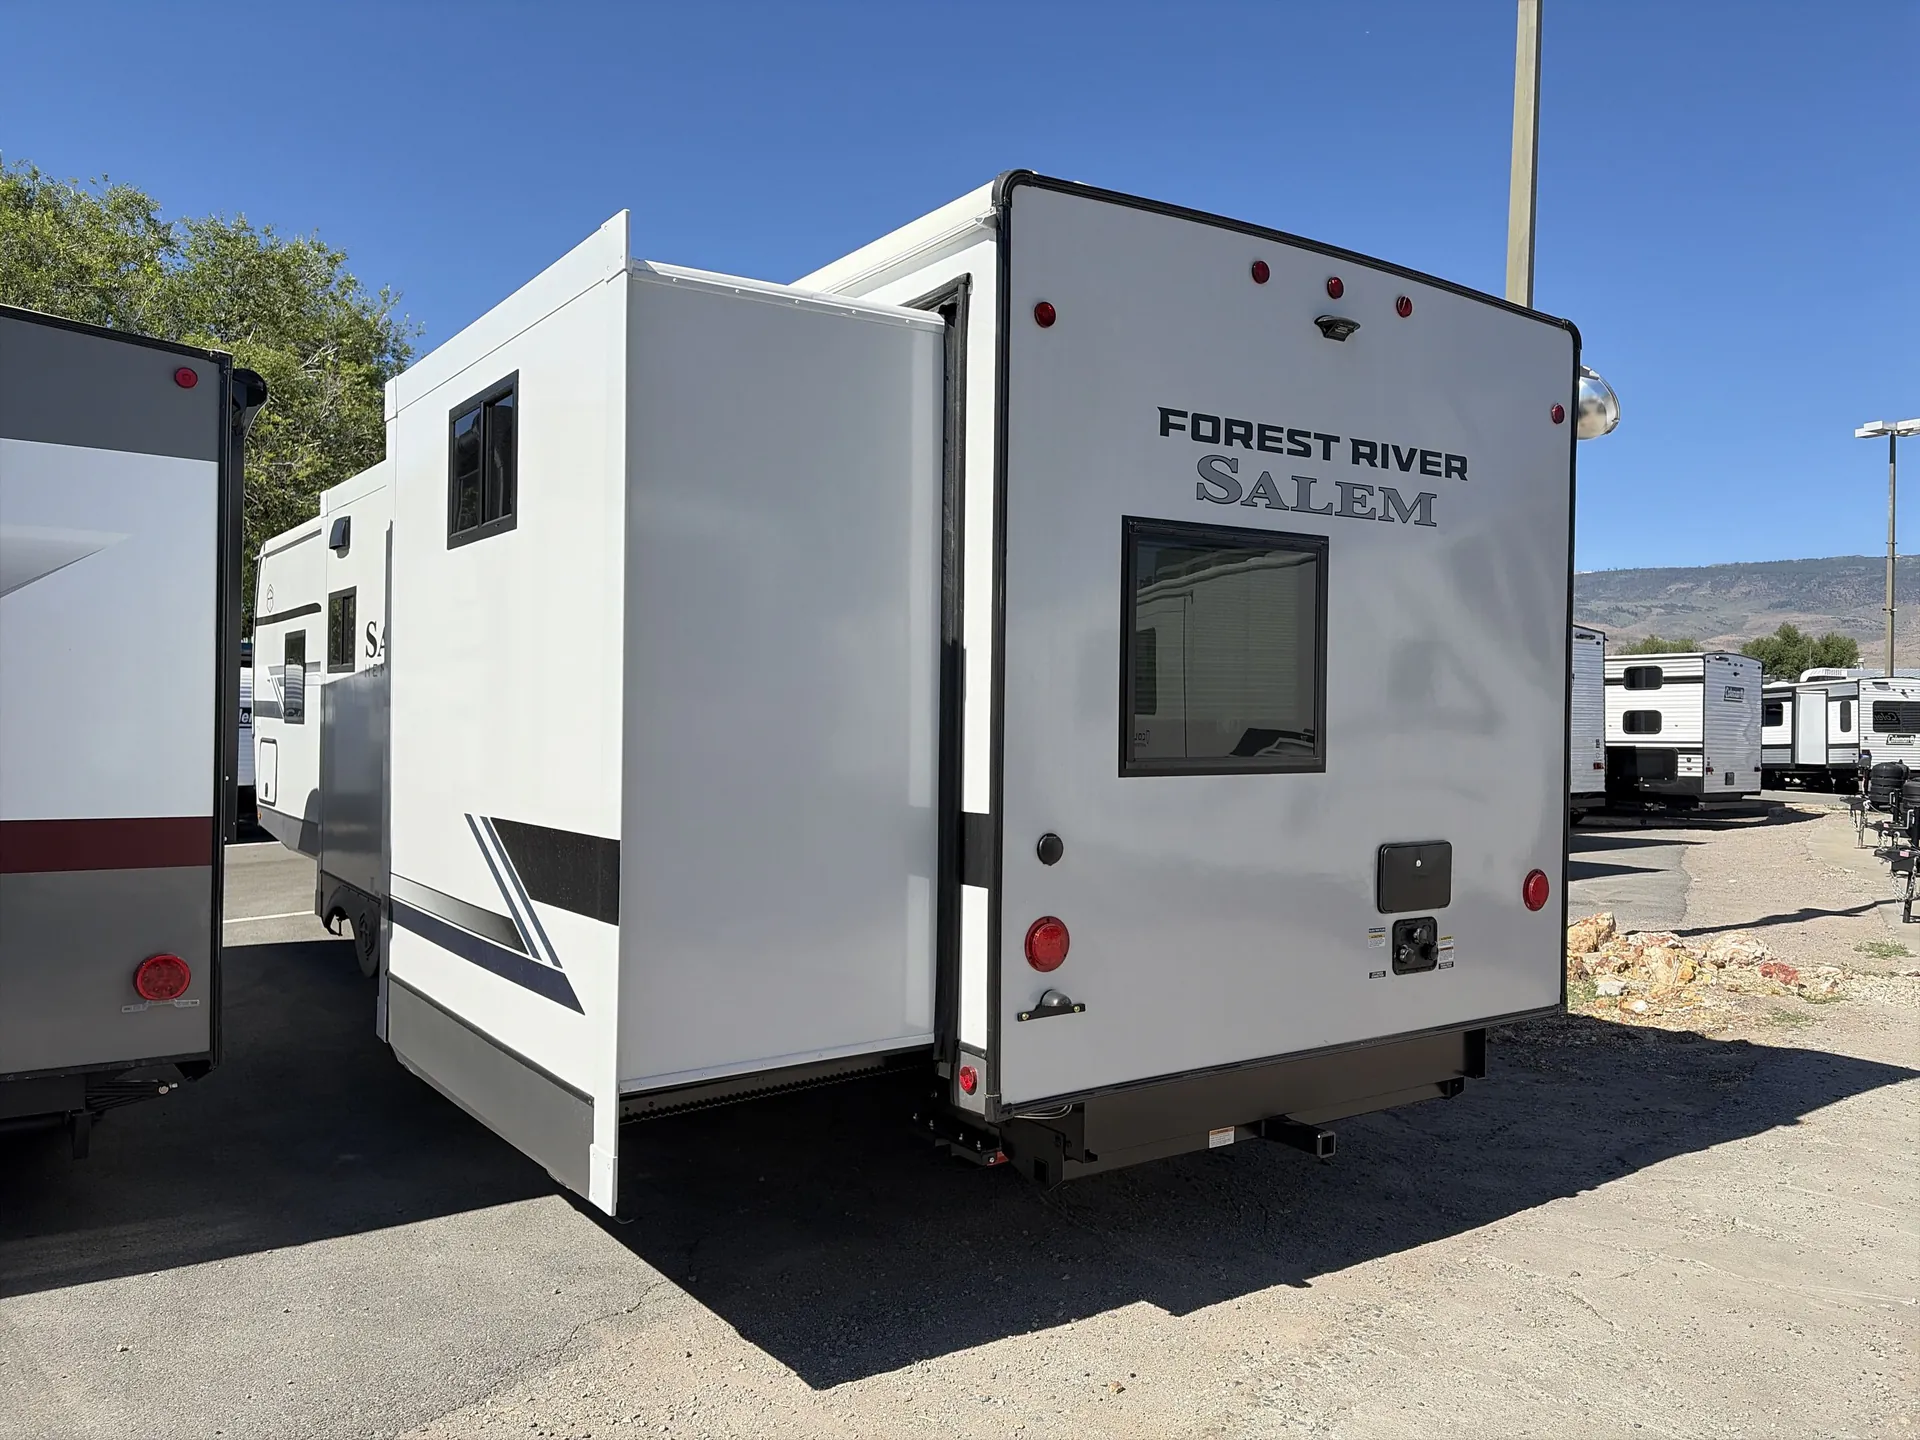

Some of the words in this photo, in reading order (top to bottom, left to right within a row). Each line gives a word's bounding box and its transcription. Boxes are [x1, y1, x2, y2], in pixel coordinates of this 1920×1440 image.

[1157, 406, 1341, 461] FOREST
[1349, 437, 1468, 481] RIVER
[1196, 454, 1437, 527] SALEM
